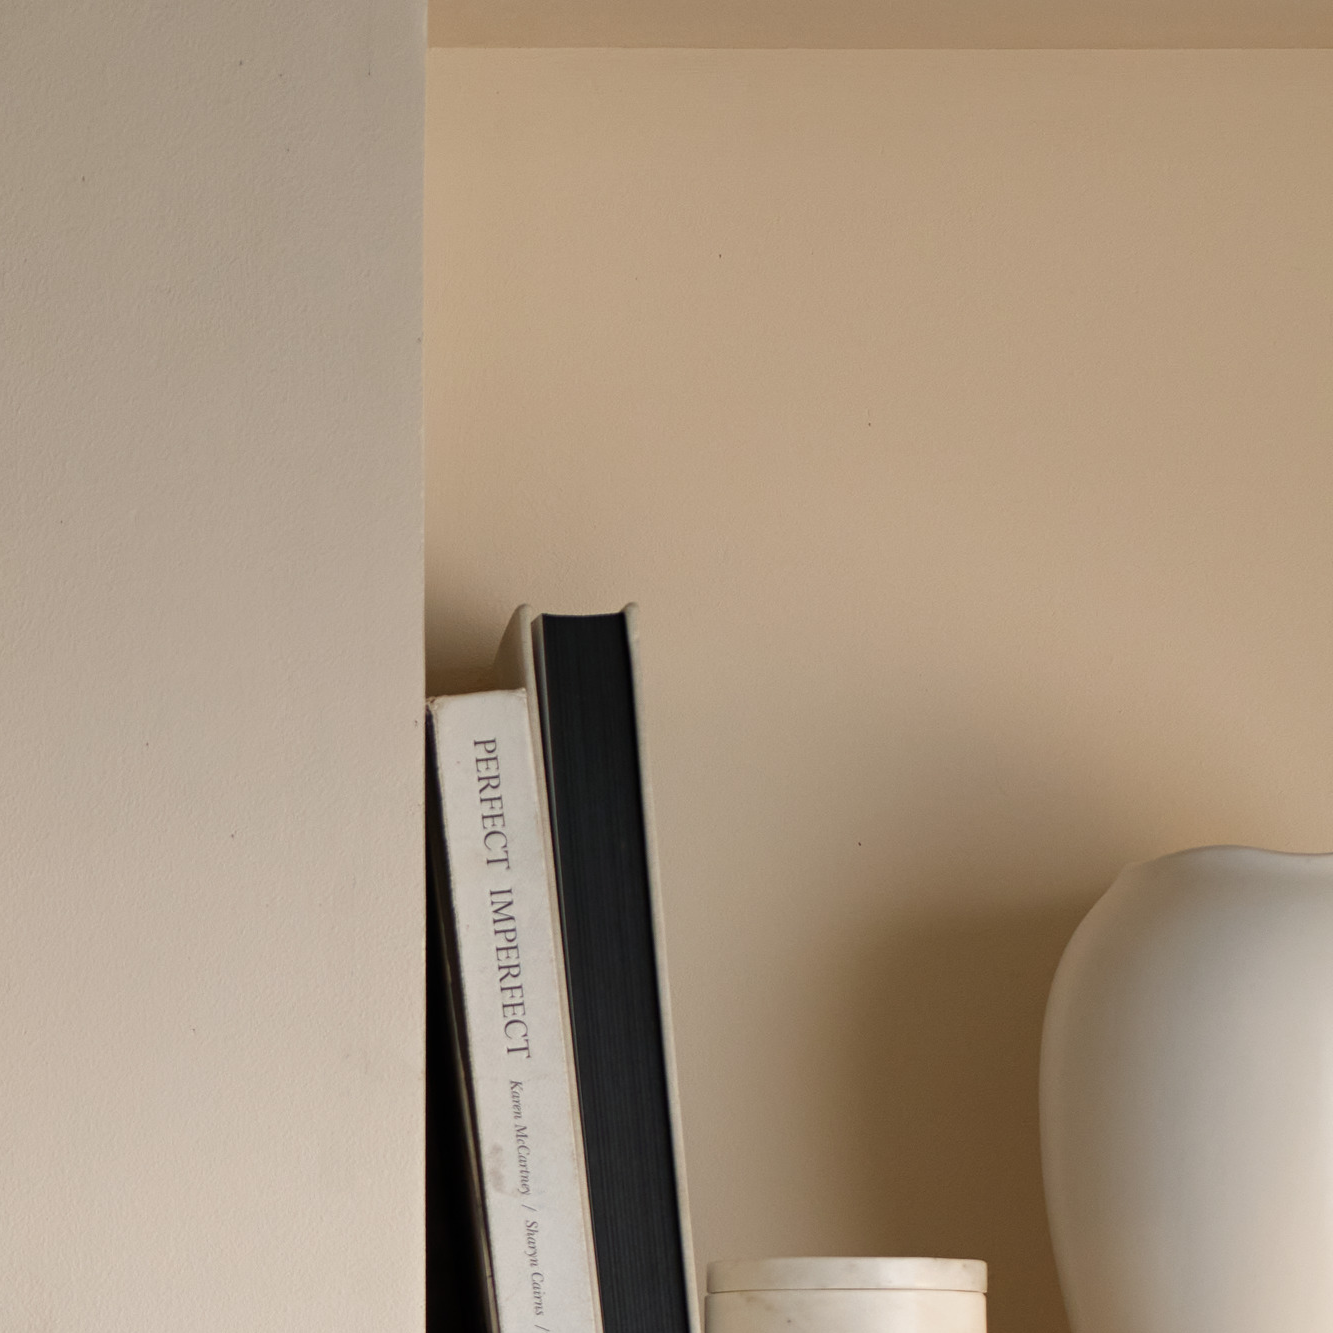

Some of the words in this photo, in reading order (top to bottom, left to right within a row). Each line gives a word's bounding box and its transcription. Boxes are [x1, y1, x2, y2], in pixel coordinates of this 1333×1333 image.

[473, 737, 511, 870] PERFECT
[489, 888, 532, 1059] IMPERFECT
[510, 1080, 524, 1119] Karen
[515, 1124, 532, 1196] McCartney
[524, 1220, 539, 1267] Sharyn
[531, 1271, 546, 1316] Cairns
